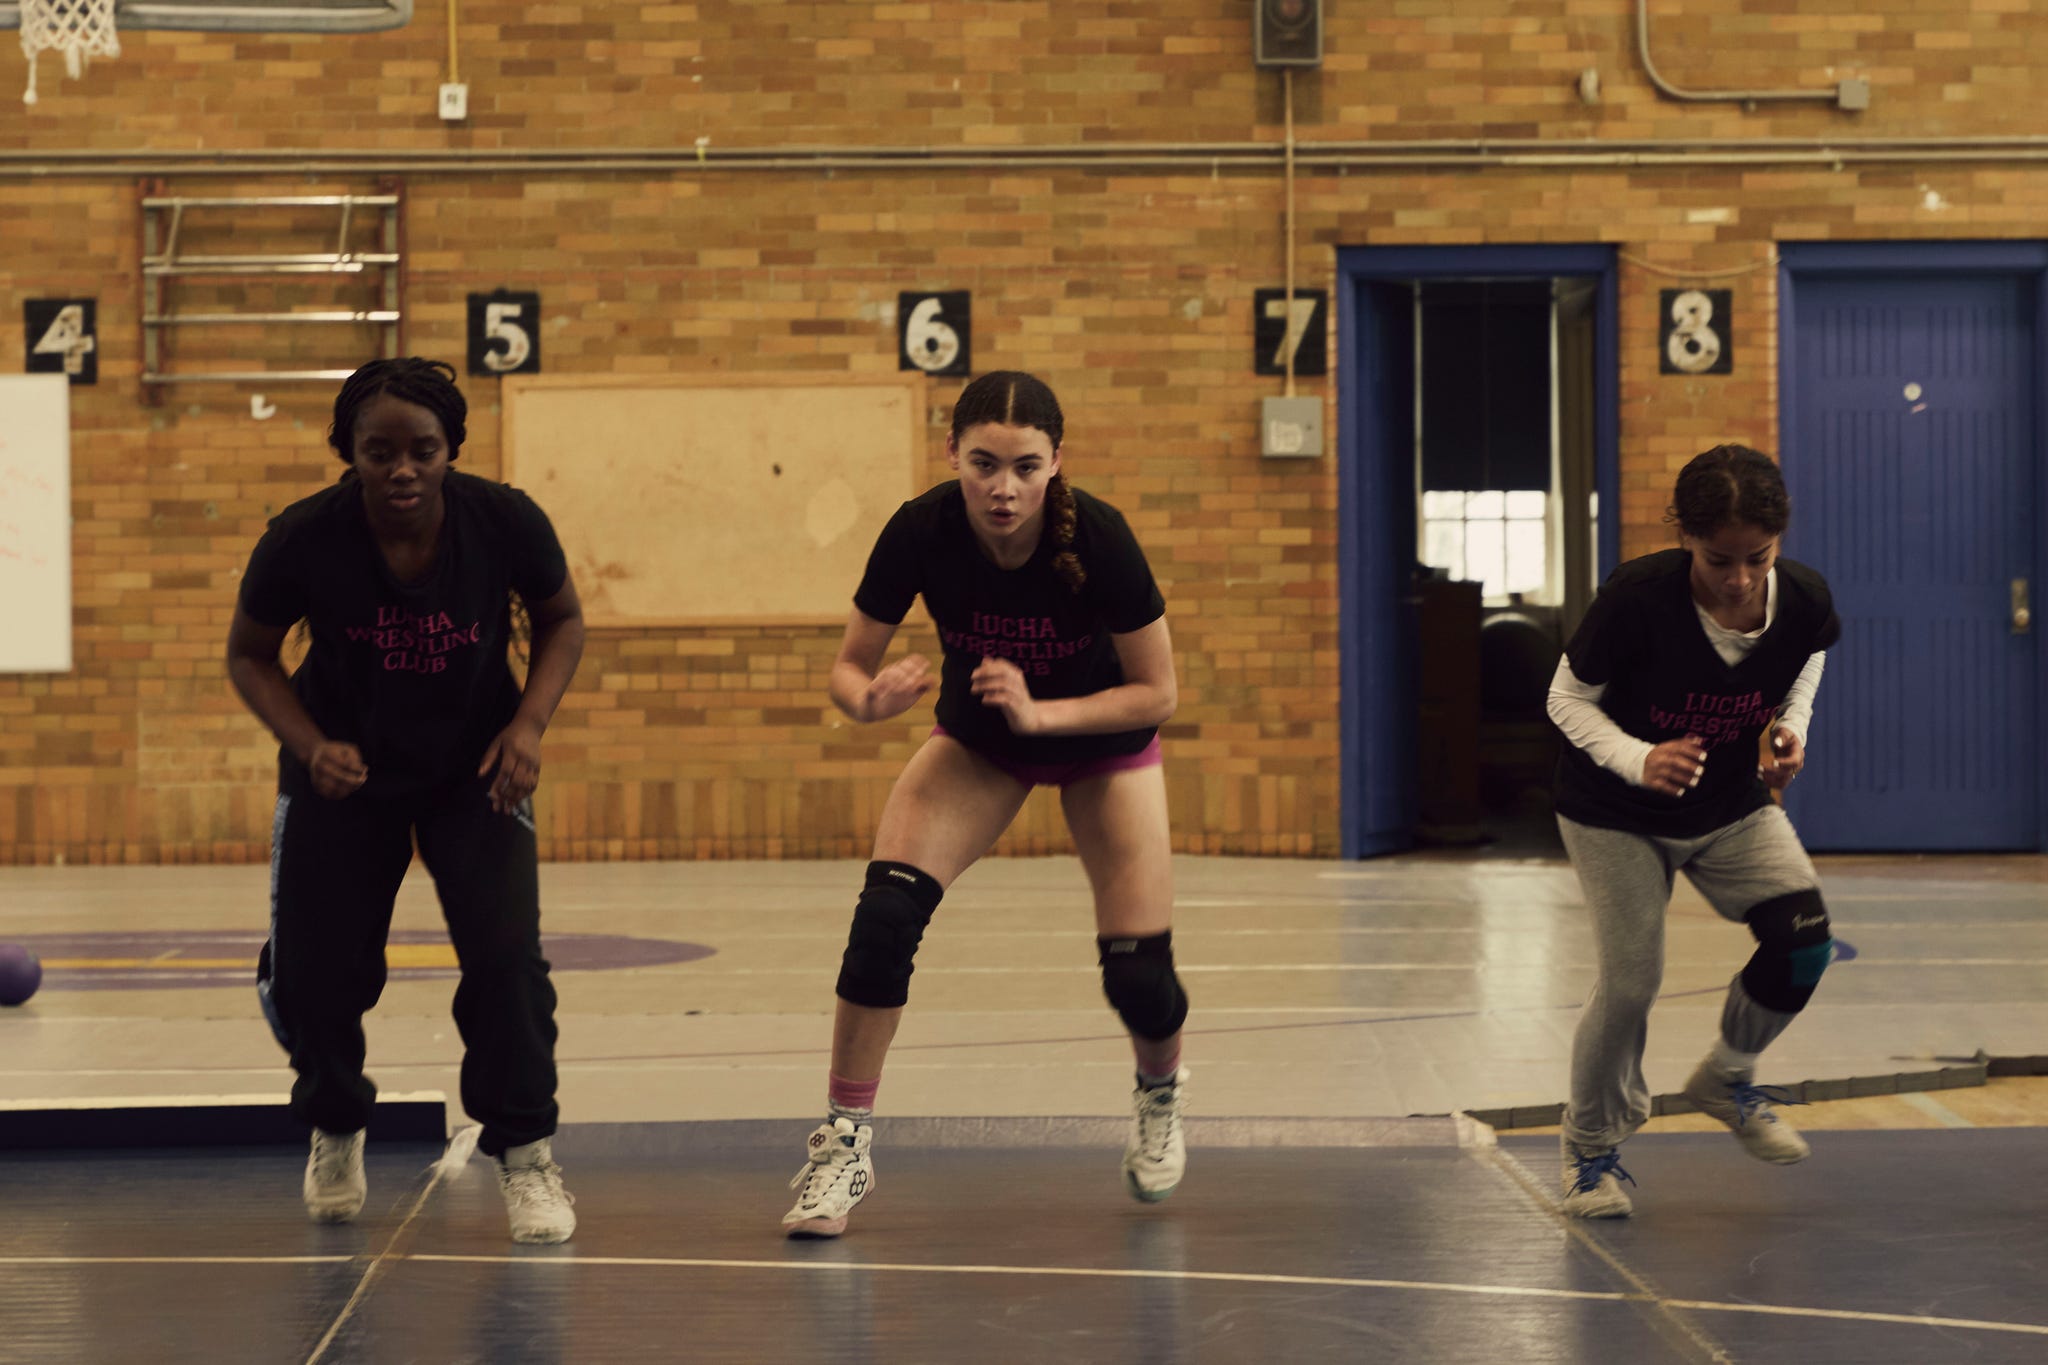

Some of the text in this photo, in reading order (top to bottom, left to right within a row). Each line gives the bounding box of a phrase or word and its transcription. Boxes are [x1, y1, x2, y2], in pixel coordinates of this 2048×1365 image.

[33, 304, 94, 375] 4
[483, 303, 530, 371] 5
[906, 297, 959, 371] 6
[1265, 298, 1317, 366] 7
[1667, 290, 1721, 373] 8
[972, 611, 1057, 639] LUCHA
[384, 651, 447, 674] CLUB
[1684, 690, 1763, 715] LUCHA
